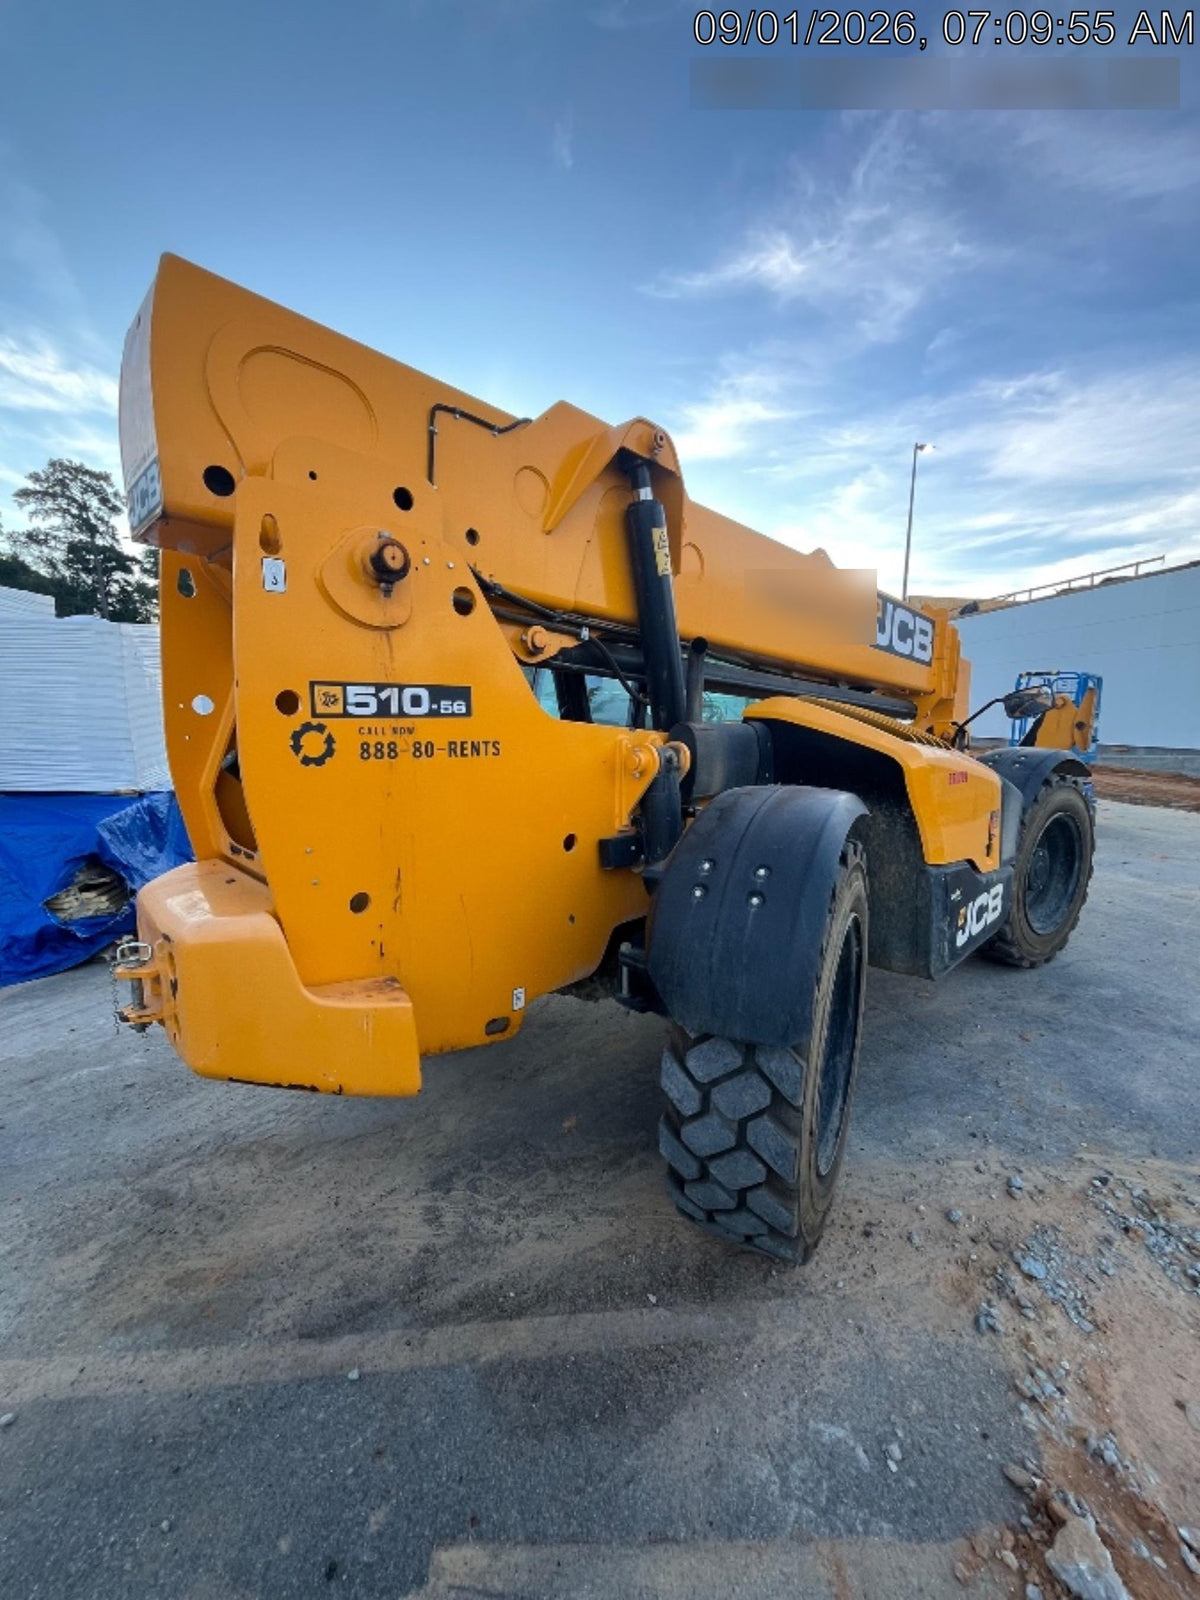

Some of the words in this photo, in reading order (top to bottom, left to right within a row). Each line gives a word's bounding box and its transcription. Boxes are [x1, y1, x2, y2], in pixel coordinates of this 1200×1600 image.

[877, 602, 933, 662] JCB
[358, 726, 386, 736] CALL
[391, 726, 415, 736] NOW
[956, 883, 1004, 947] JCB
